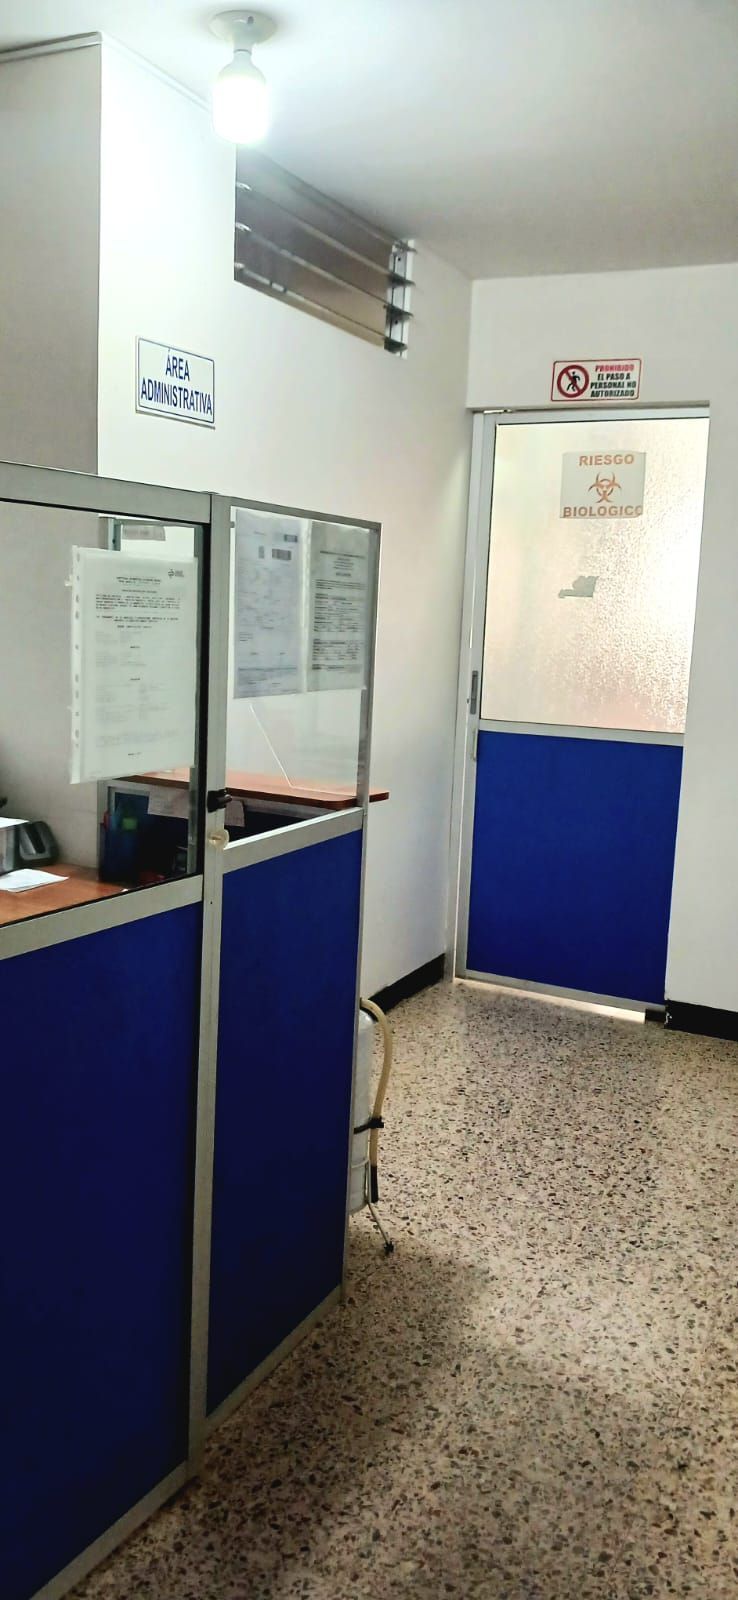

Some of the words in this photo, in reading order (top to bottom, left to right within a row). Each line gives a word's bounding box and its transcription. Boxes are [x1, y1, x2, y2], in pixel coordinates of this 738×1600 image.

[597, 373, 604, 381] EL
[141, 377, 213, 415] ADMINISTRATIVA
[579, 454, 634, 466] RIESGO
[563, 505, 643, 517] BIOLOGICO
